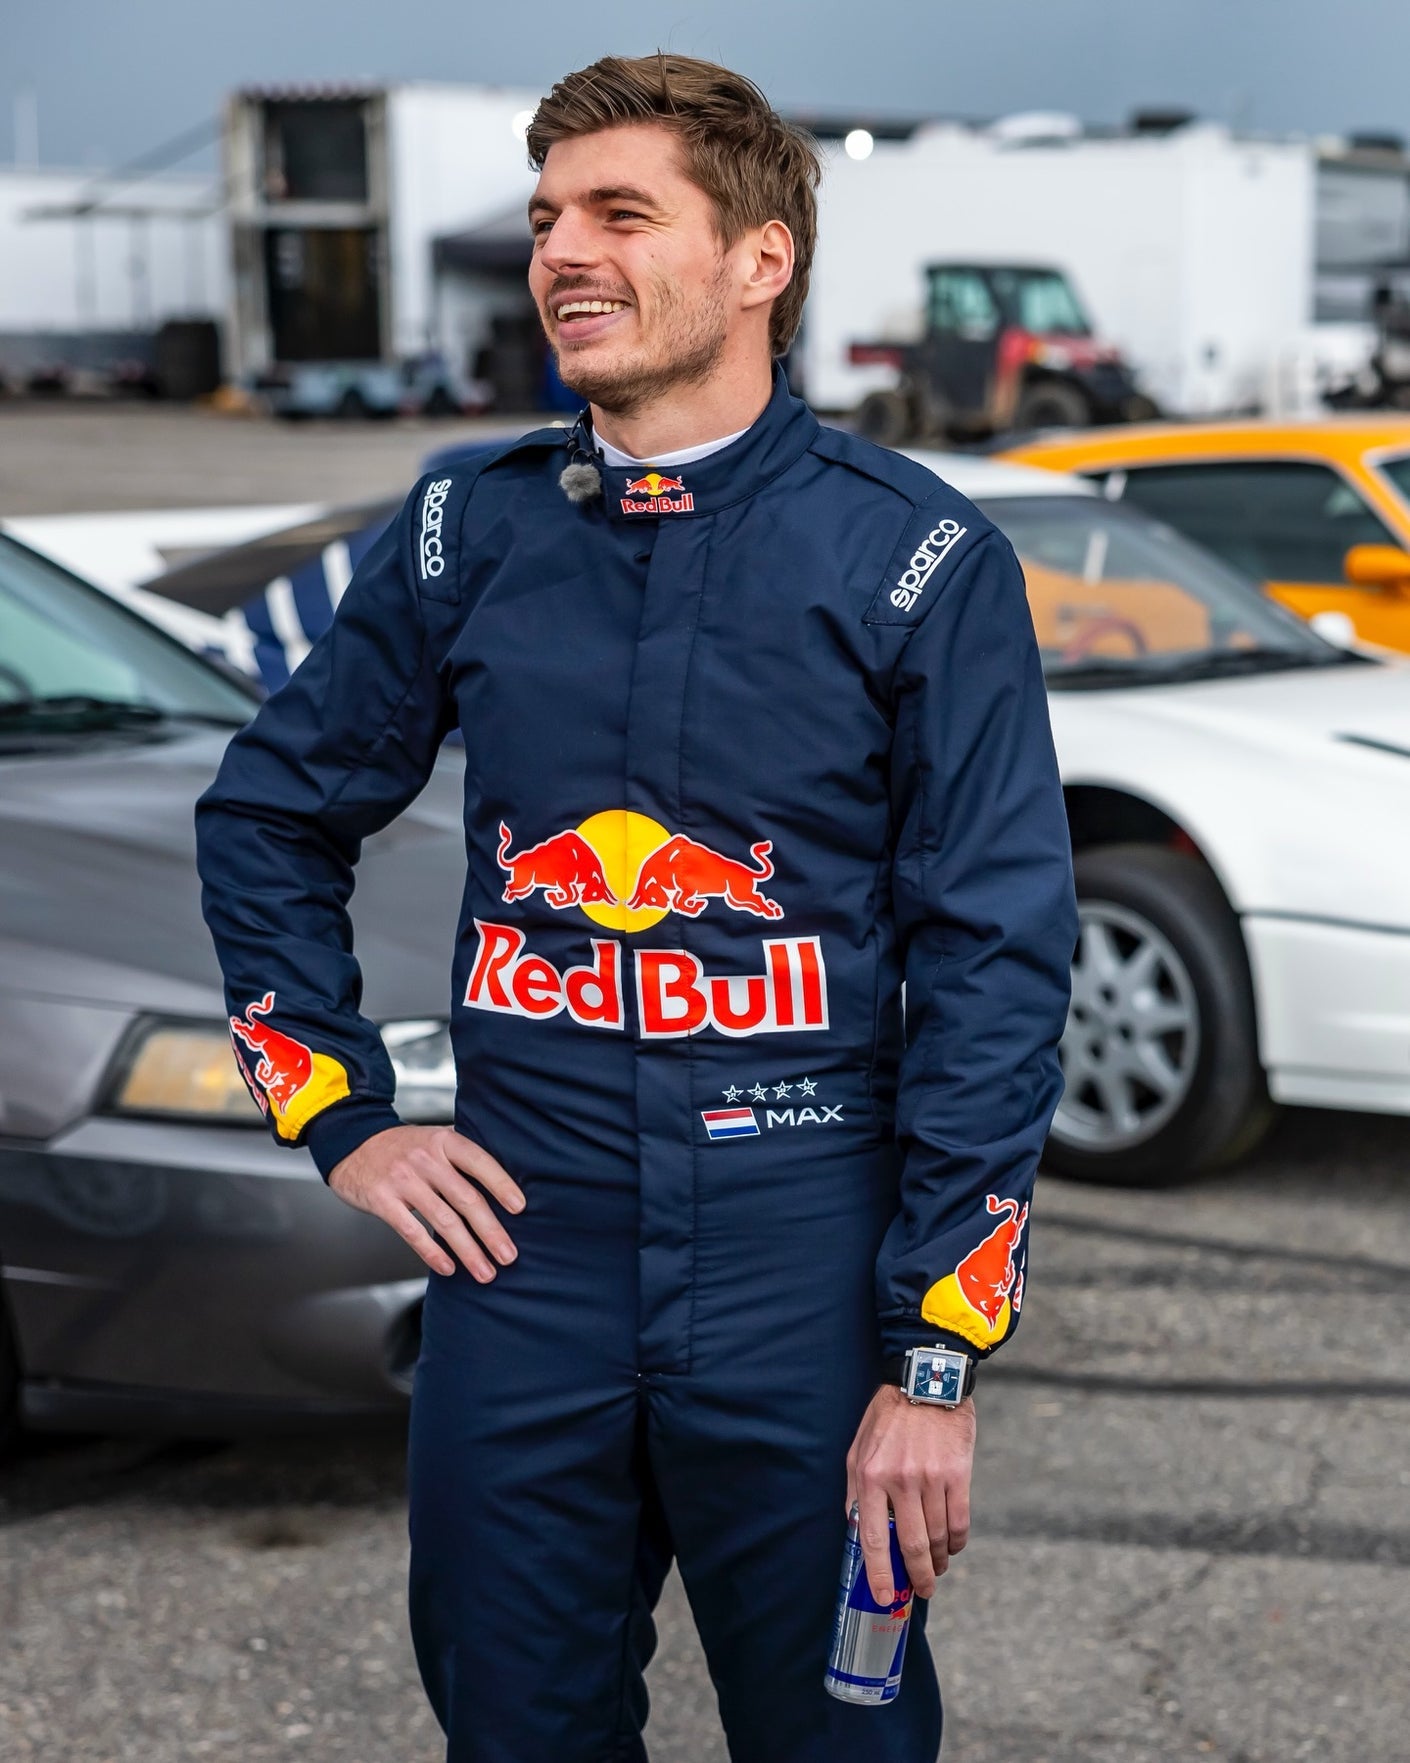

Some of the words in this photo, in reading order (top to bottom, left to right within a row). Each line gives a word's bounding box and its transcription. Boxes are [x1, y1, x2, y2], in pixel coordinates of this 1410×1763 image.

[421, 479, 452, 579] sparco
[620, 497, 658, 514] Red
[658, 492, 694, 513] Bull
[890, 519, 966, 612] sparco
[463, 918, 625, 1031] Red
[633, 936, 830, 1039] Bull
[766, 1104, 845, 1128] MAX
[893, 1588, 909, 1602] ed
